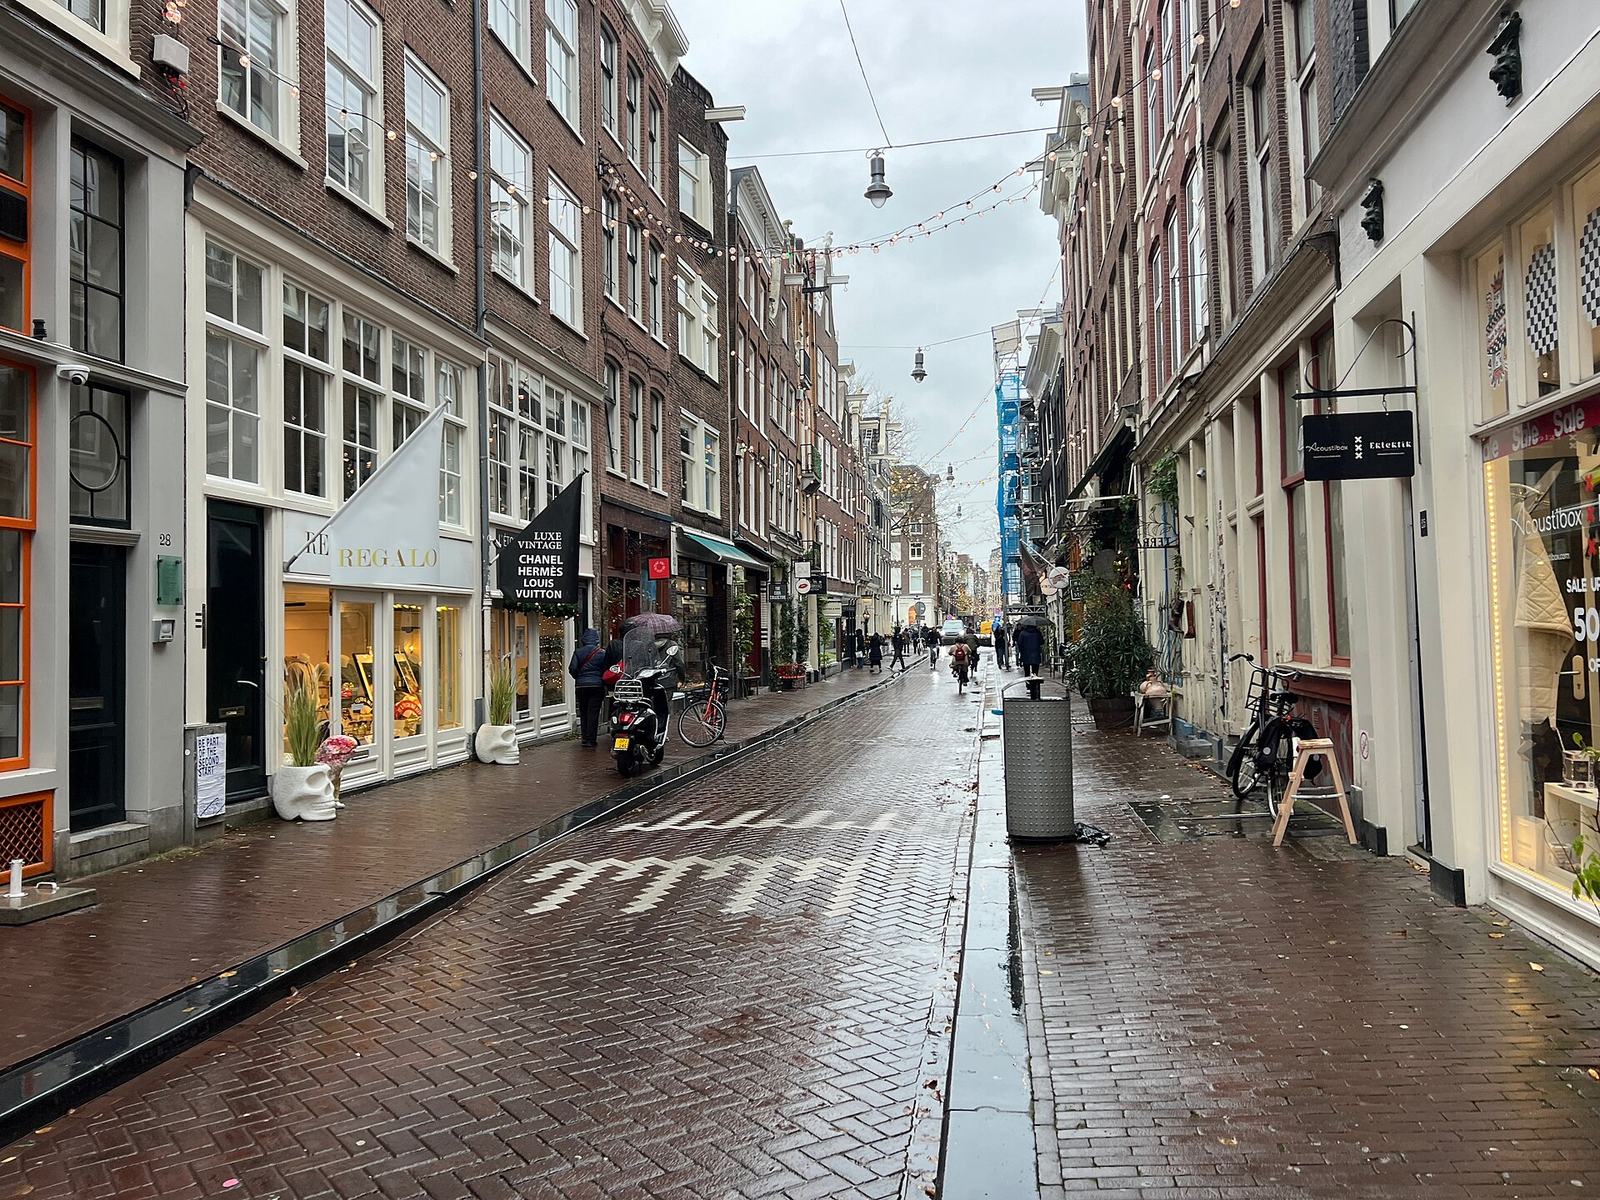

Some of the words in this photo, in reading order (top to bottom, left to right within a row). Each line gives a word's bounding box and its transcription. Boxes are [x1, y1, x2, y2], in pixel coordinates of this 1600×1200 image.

[1512, 422, 1539, 451] Sale
[1553, 406, 1585, 437] Sale
[1305, 442, 1348, 453] Acoustibox
[1369, 441, 1412, 449] Eklektik
[1510, 507, 1583, 536] Acoustibox
[159, 533, 171, 546] 28
[534, 531, 562, 540] LUXE
[517, 540, 562, 550] VINTAGE
[337, 548, 437, 568] REGALO
[518, 554, 564, 565] CHANEL
[517, 565, 564, 577] HERMÈS
[523, 578, 554, 588] LOUIS
[1566, 578, 1587, 593] SALE
[515, 589, 562, 599] VUITTON
[198, 738, 205, 748] BE
[206, 736, 219, 747] PART
[198, 748, 205, 758] OF
[207, 746, 217, 756] THE
[198, 755, 219, 768] SECOND
[198, 765, 214, 777] START
